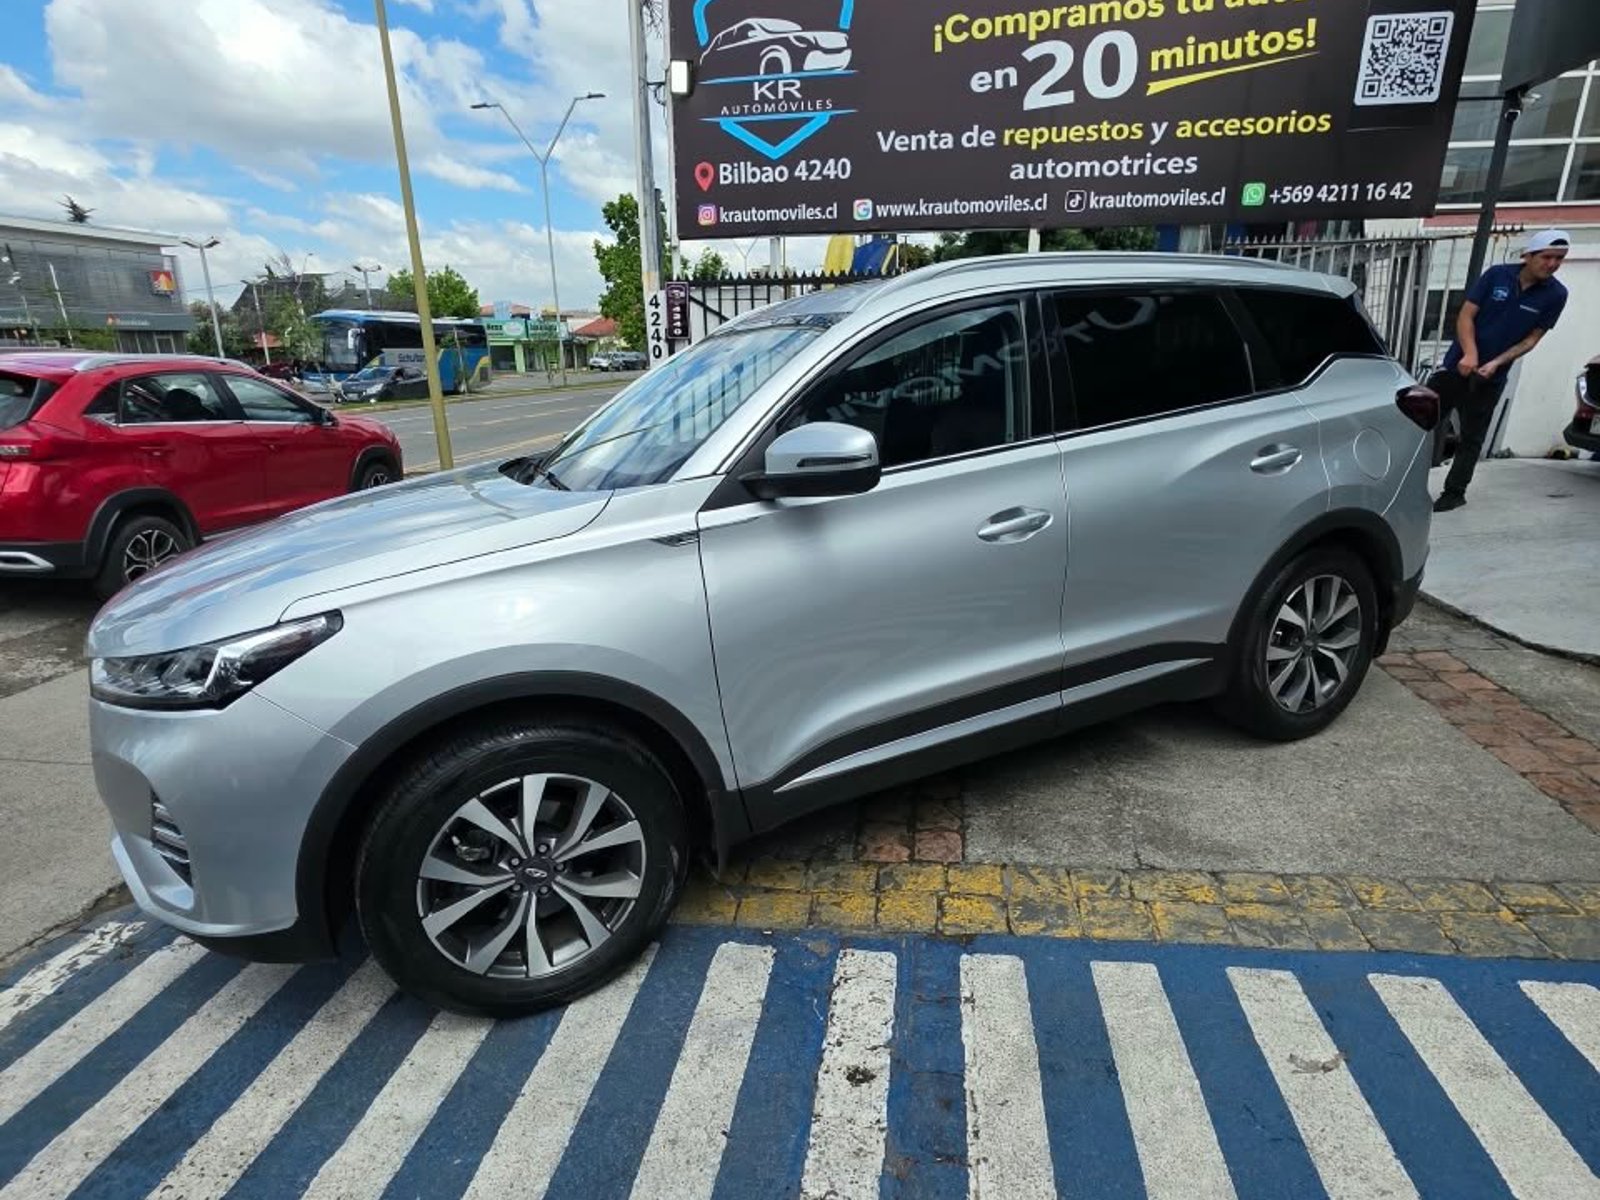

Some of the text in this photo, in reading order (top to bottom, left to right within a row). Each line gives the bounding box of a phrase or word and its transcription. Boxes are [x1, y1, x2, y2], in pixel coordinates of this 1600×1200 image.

[934, 0, 1165, 53] ¡Compramos
[969, 17, 1317, 111] en 20 minutos!
[753, 79, 802, 101] KR
[720, 98, 833, 116] AUTOMÓVILES
[876, 109, 1332, 152] Venta de repuestos y accesorios
[719, 157, 852, 185] Bilbao 4240
[1009, 151, 1198, 181] automotrices
[876, 193, 1048, 217] www.krautomoviles.cl
[1088, 186, 1226, 209] krautomoviles.cl
[1269, 181, 1413, 204] +569 4211 16 42
[719, 201, 838, 223] krautomoviles.cl
[649, 294, 662, 359] 4240
